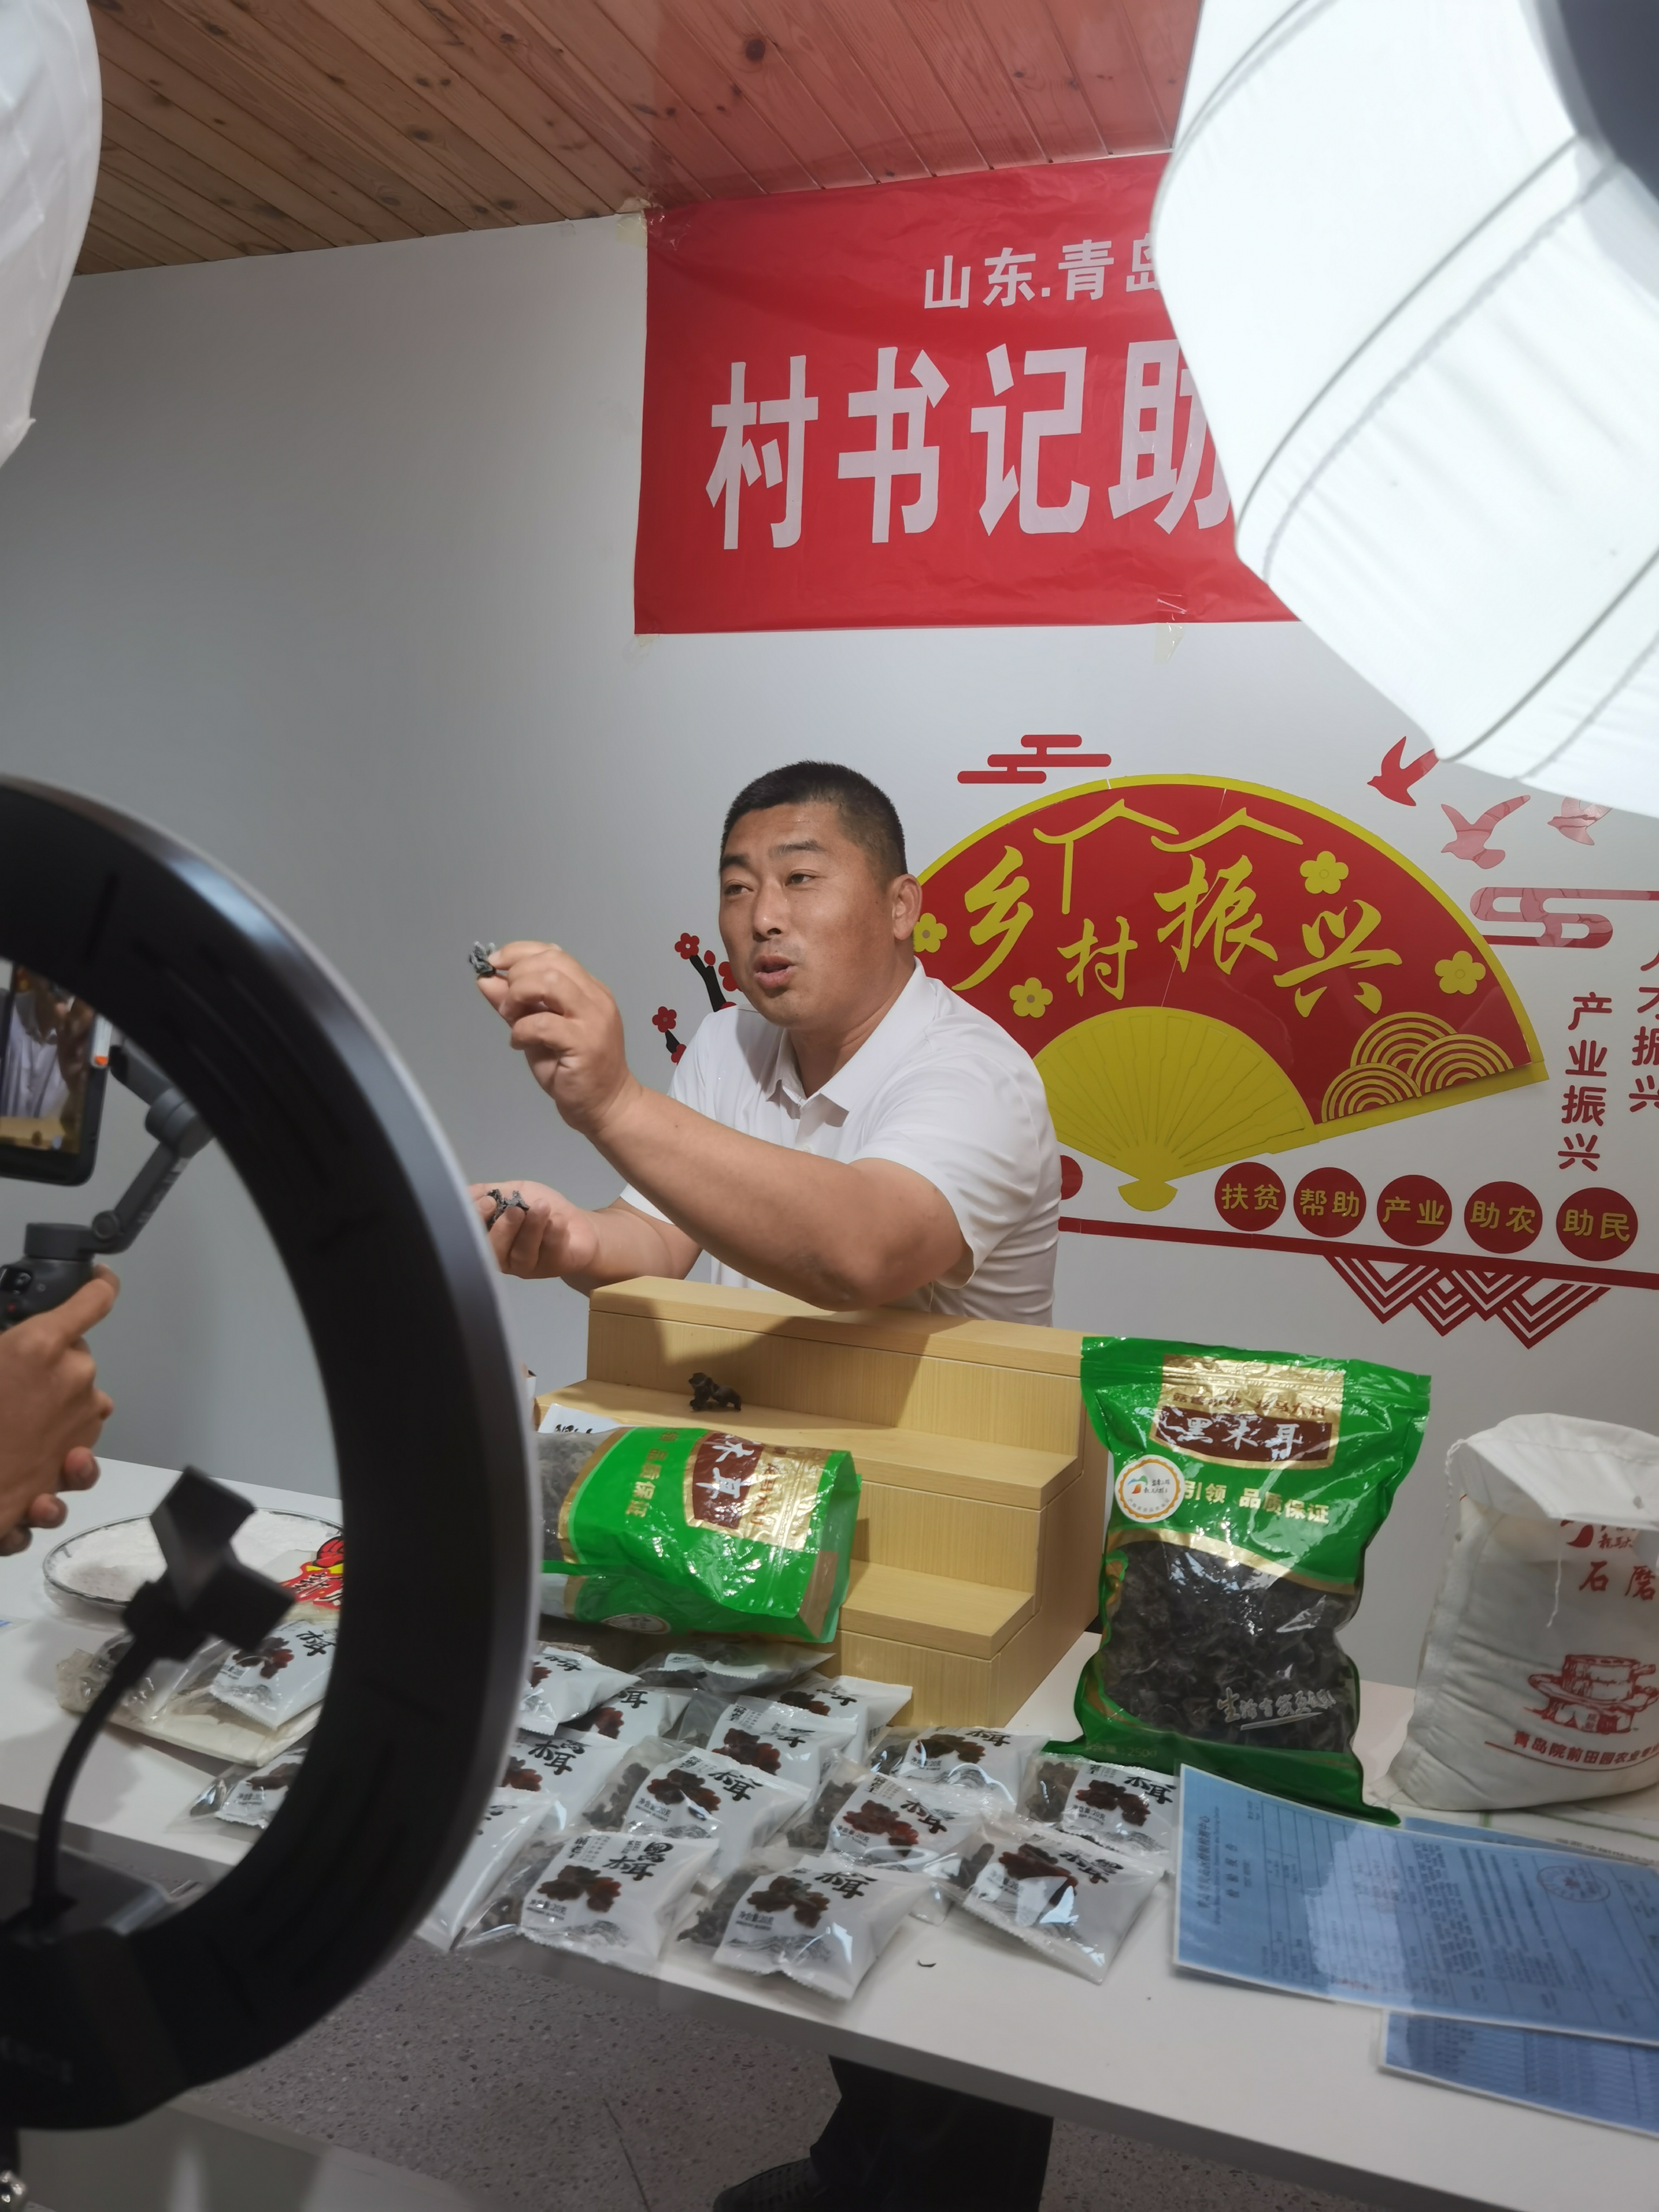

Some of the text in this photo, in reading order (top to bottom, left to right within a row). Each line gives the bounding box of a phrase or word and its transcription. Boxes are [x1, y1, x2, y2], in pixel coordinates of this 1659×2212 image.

[705, 339, 1231, 550] 村书记助
[952, 845, 1402, 1018] 乡村振兴
[1628, 949, 1659, 1114] 振兴
[1557, 992, 1613, 1172] 产业振兴
[1221, 1183, 1630, 1243] 扶贫 帮助 产业 助农 助民
[696, 1434, 760, 1500] 木耳
[1177, 1417, 1304, 1459] 黑木耳
[1184, 1480, 1228, 1503] 引领
[1239, 1487, 1330, 1525] 品质保证
[1579, 1560, 1656, 1601] 石磨
